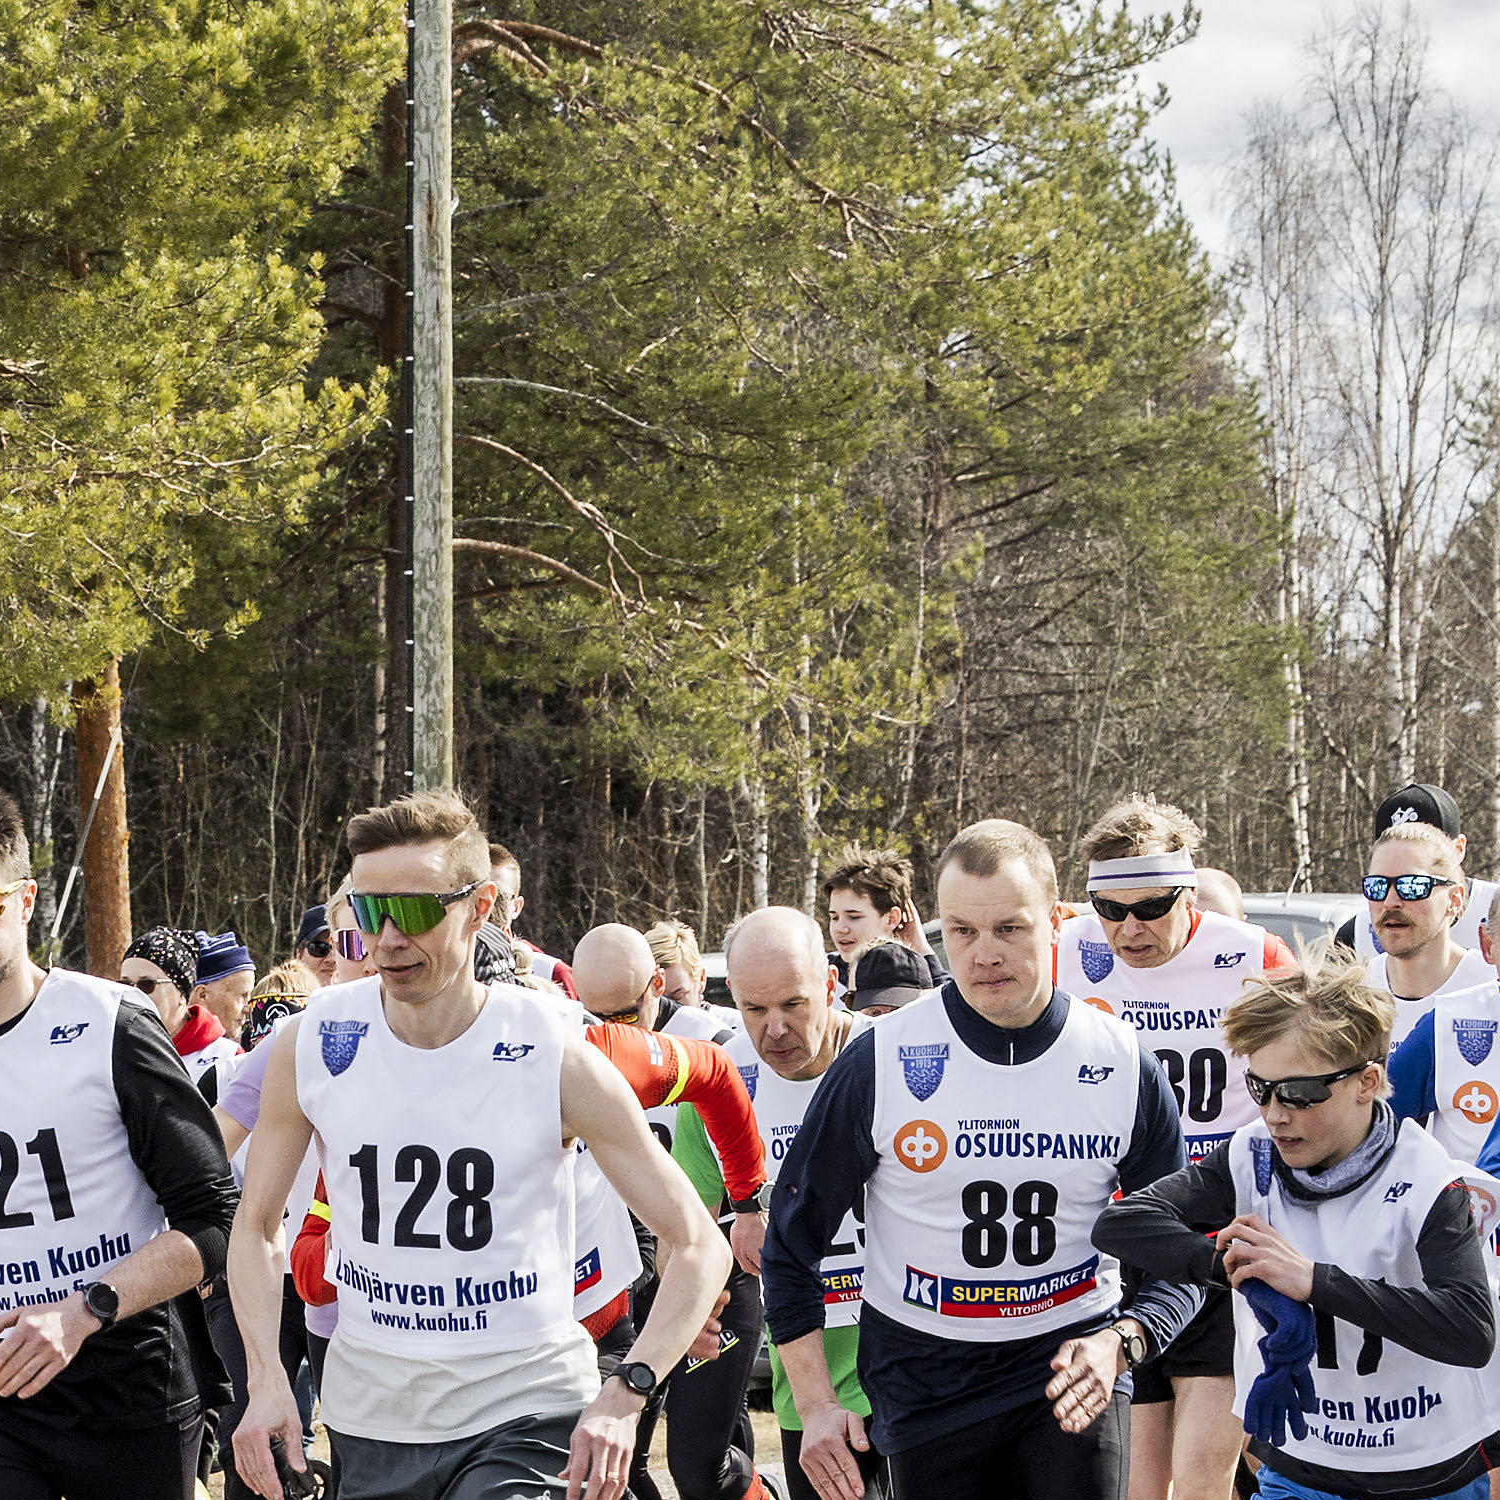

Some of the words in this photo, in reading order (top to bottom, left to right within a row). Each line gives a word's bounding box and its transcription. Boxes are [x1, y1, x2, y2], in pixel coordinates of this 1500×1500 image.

[1122, 1000, 1170, 1010] YLITORNION
[1121, 1007, 1222, 1031] OSUUSPAN
[1461, 1020, 1490, 1029] KUOHU
[1467, 1032, 1482, 1040] 1913
[910, 1046, 938, 1057] KUOHU
[916, 1060, 932, 1069] 1913
[957, 1119, 1020, 1130] YLITORNION
[955, 1133, 1121, 1159] OSUUSPANKKI
[349, 1144, 494, 1251] 128
[962, 1180, 1059, 1269] 88
[48, 1232, 131, 1279] Kuohu
[336, 1249, 445, 1306] Lohijärven
[456, 1270, 537, 1307] Kuohu
[907, 1272, 934, 1306] K
[952, 1266, 1092, 1302] SUPERMARKET
[999, 1298, 1054, 1317] YLITORNIO
[371, 1309, 488, 1332] www.kuohu.fi
